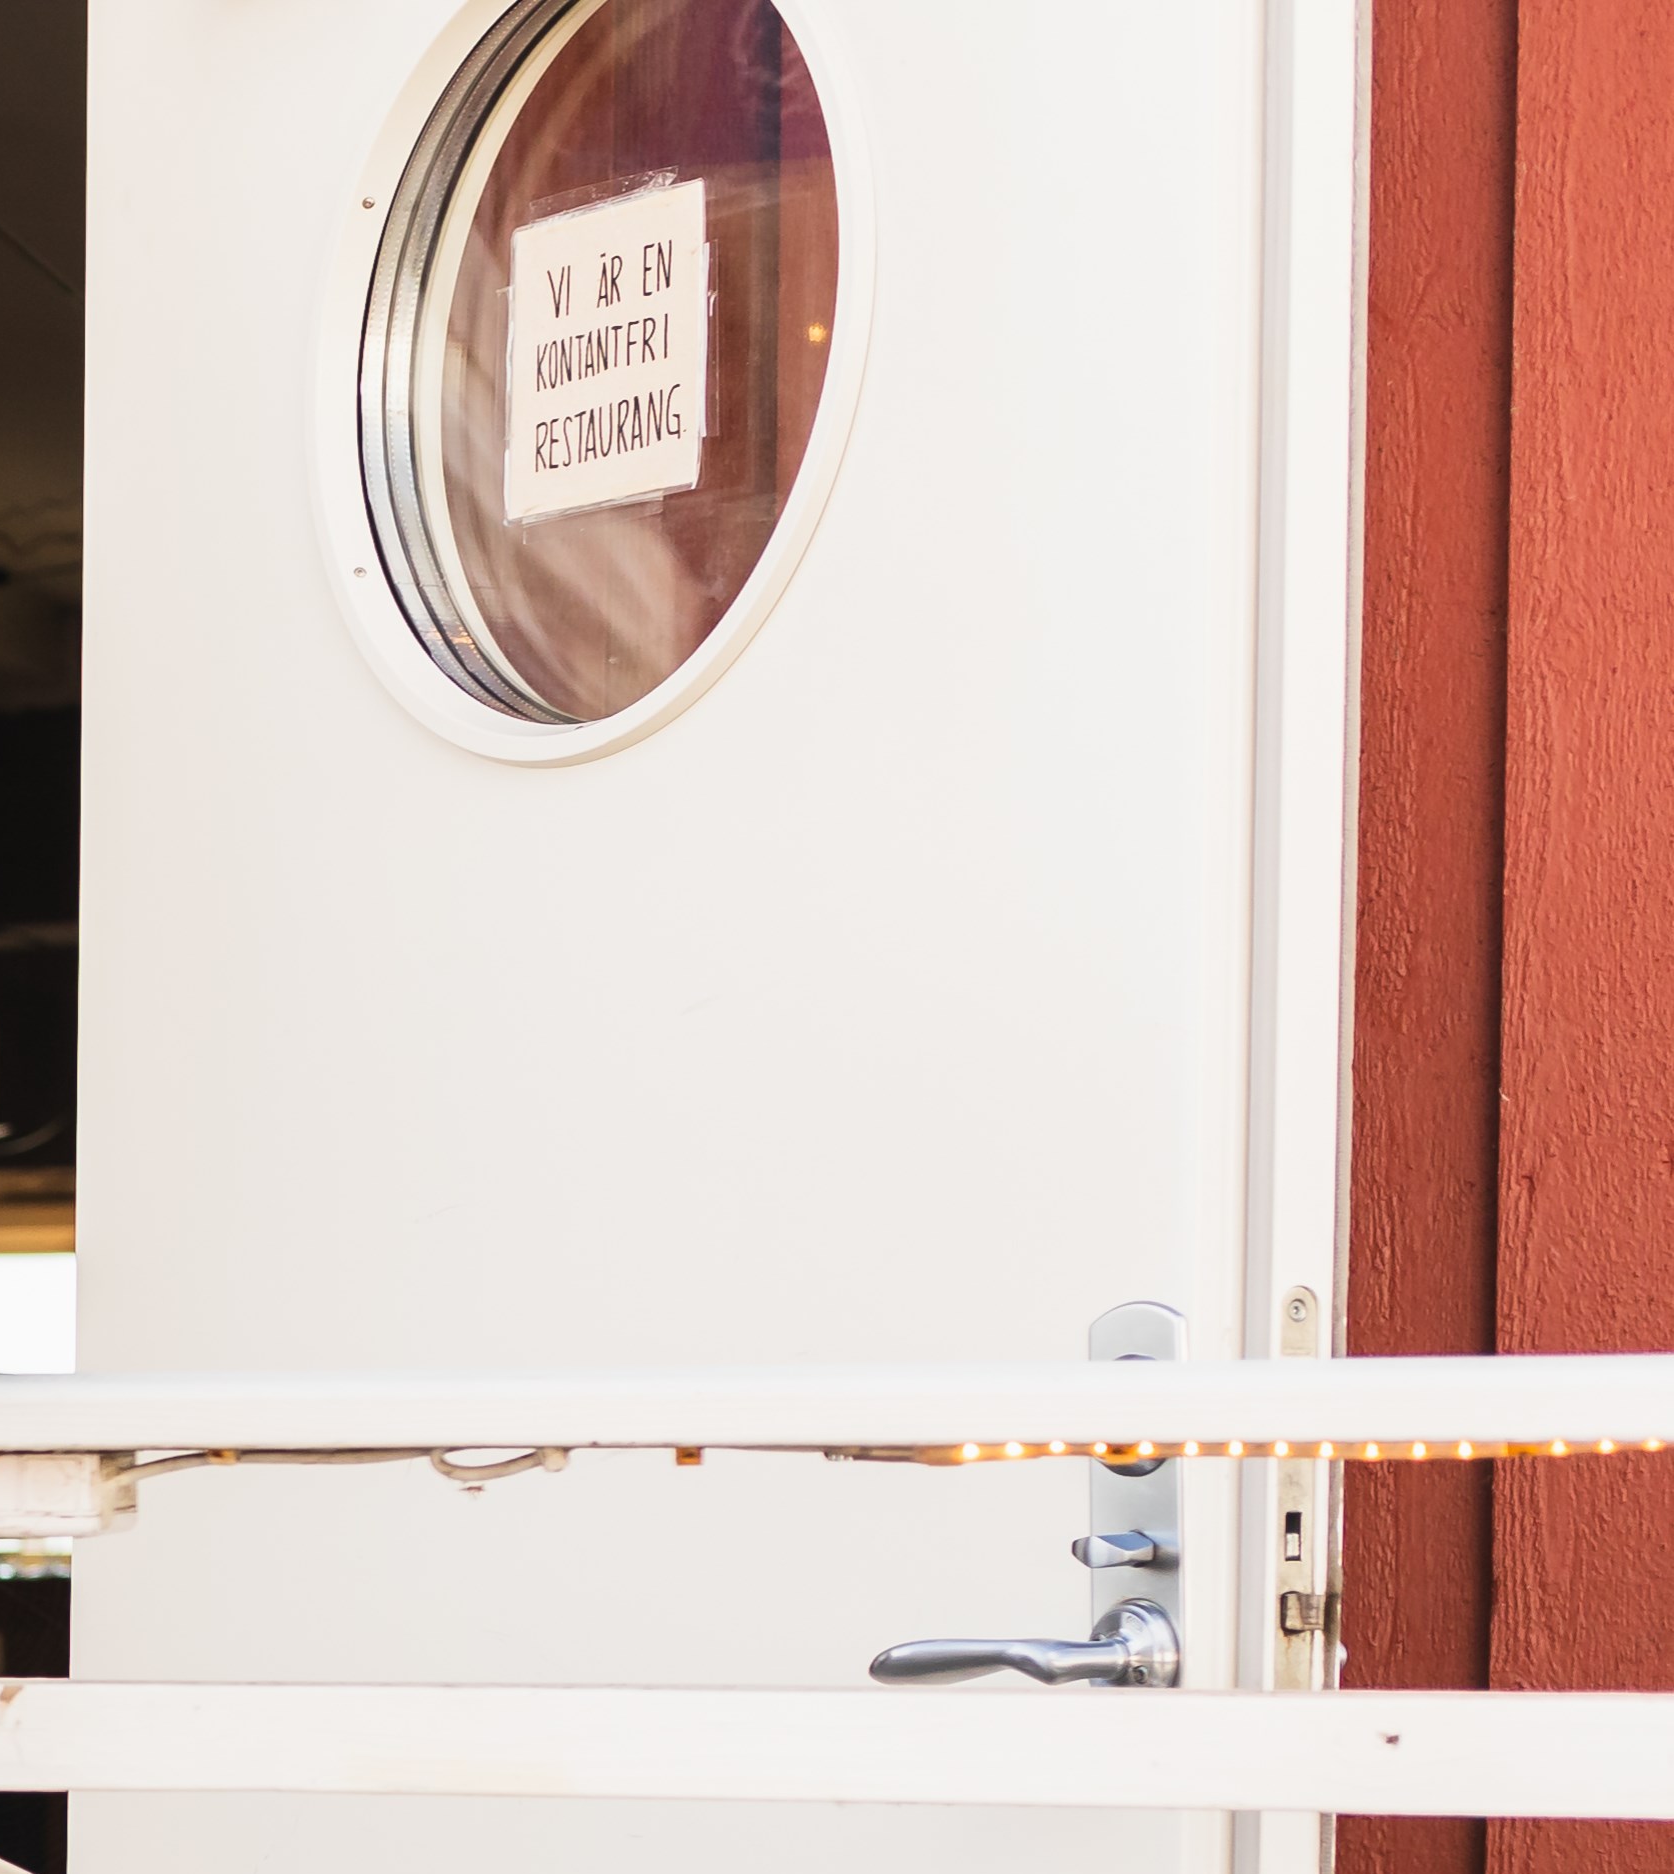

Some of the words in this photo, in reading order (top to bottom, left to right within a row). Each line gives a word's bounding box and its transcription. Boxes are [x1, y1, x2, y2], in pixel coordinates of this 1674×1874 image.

[546, 264, 572, 319] VI
[596, 252, 624, 309] ÄR
[641, 239, 673, 298] EN
[535, 312, 669, 393] KONTANTFRI
